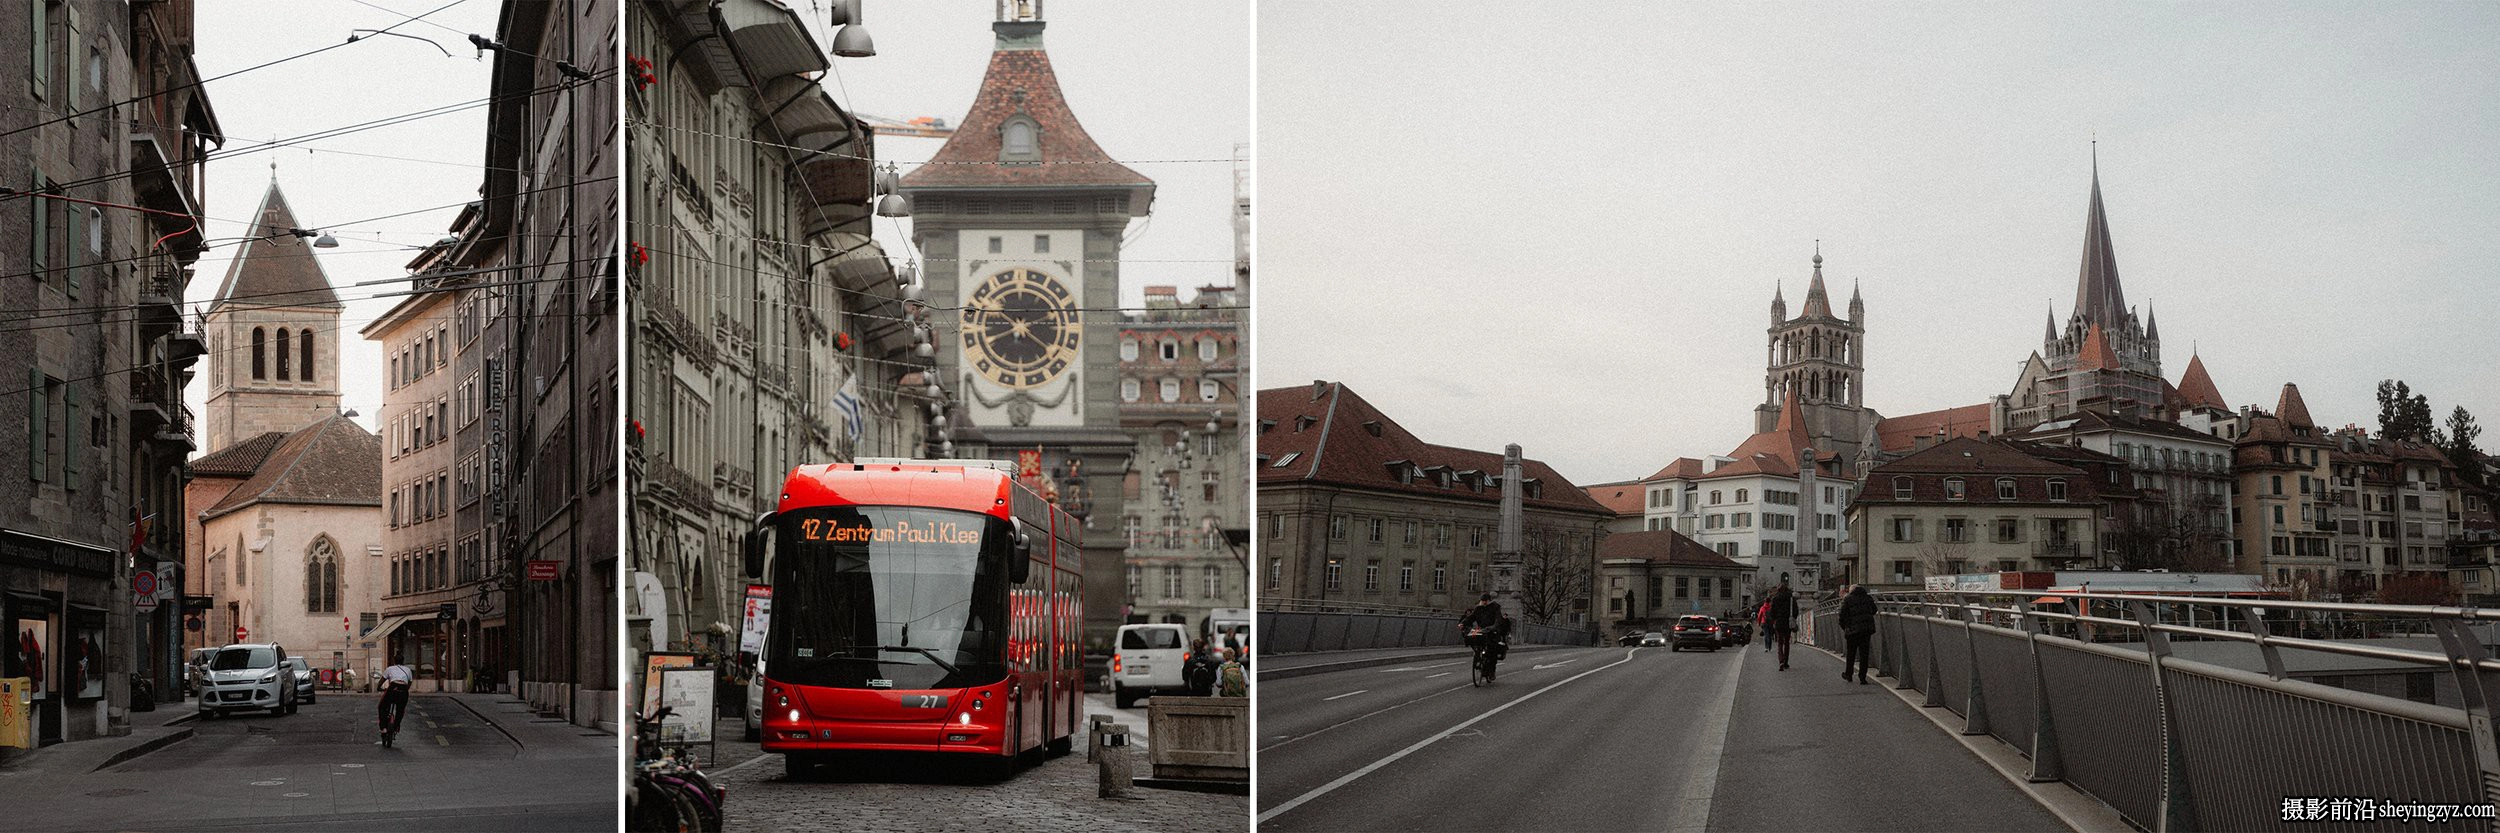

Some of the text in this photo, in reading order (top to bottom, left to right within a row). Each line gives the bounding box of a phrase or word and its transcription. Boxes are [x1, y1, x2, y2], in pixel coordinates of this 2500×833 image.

[802, 519, 979, 544] 12 Zentrum Paul Klee
[920, 695, 938, 708] 27
